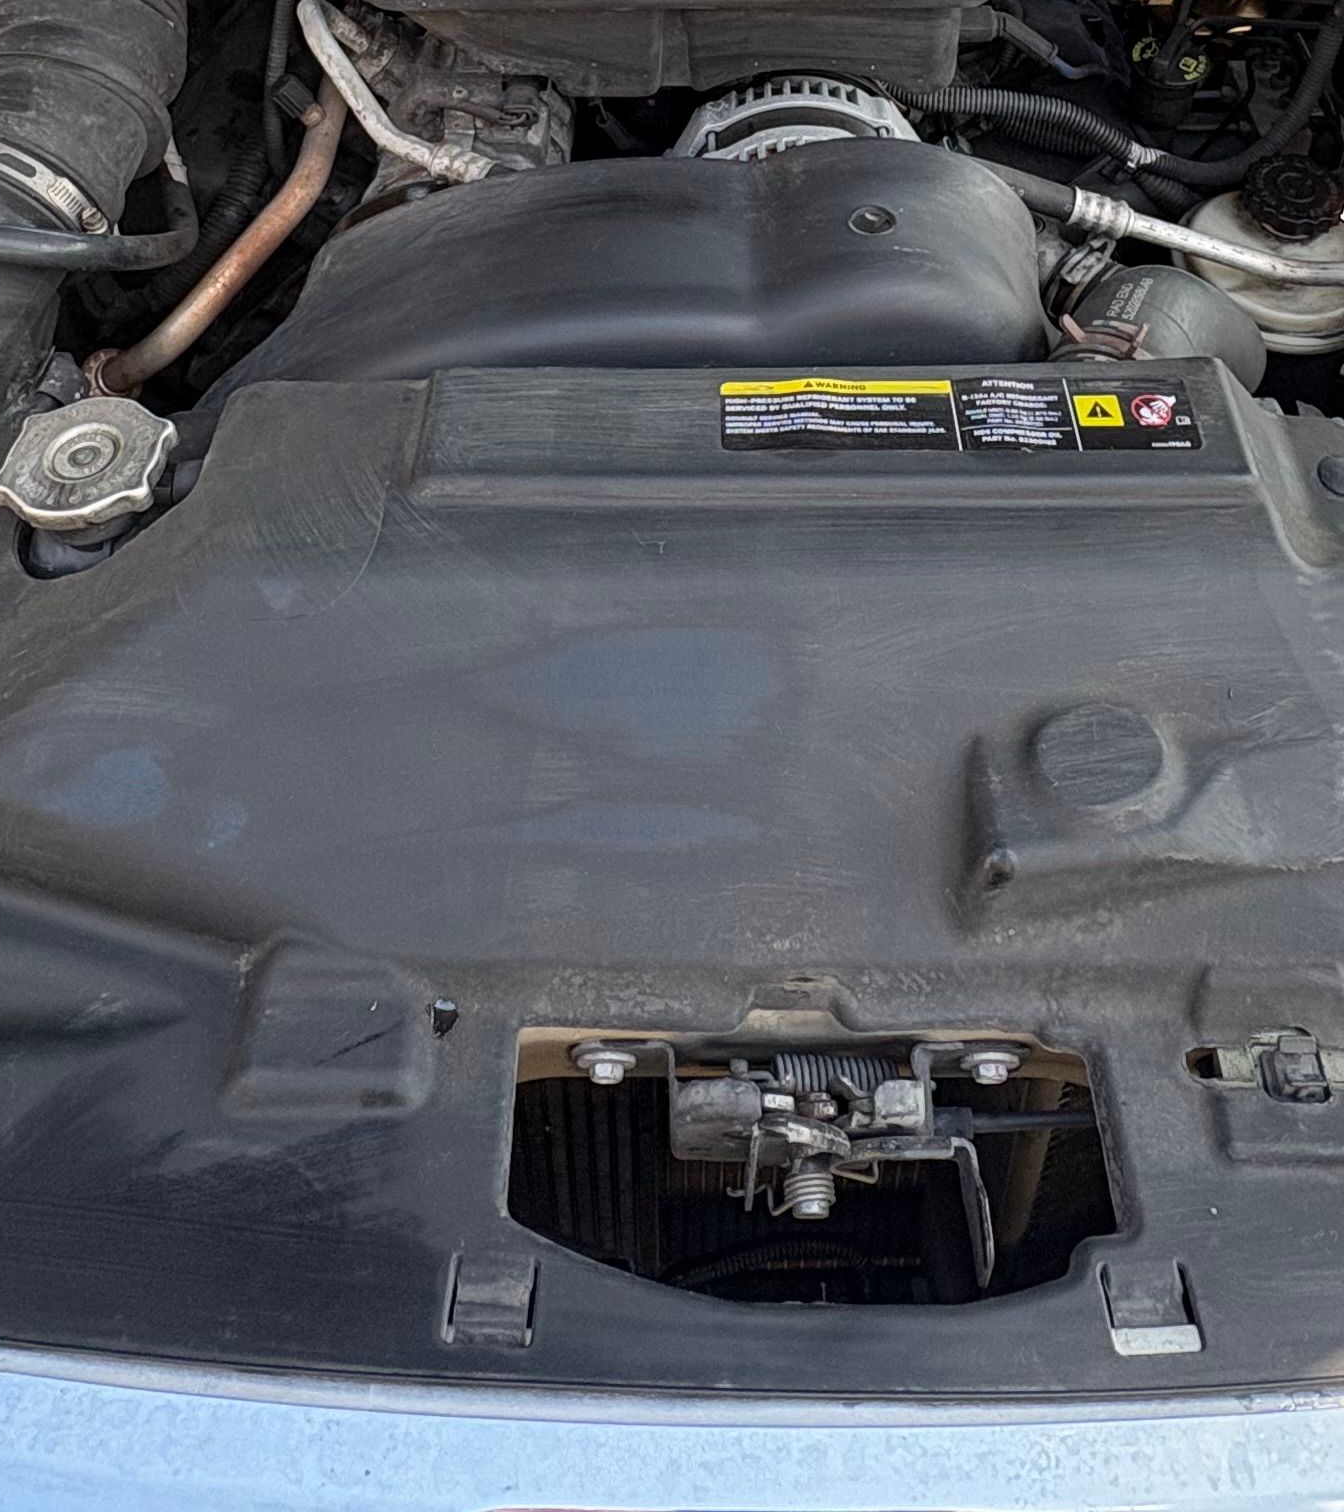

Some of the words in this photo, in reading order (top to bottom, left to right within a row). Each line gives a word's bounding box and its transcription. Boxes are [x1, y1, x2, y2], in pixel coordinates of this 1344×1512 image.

[1106, 299, 1125, 317] RAD
[1116, 283, 1134, 299] END
[815, 381, 867, 391] WARNING
[981, 379, 1034, 390] ATTENTION
[781, 402, 828, 410] QUALIFIED
[829, 402, 880, 411] PERSONNEL
